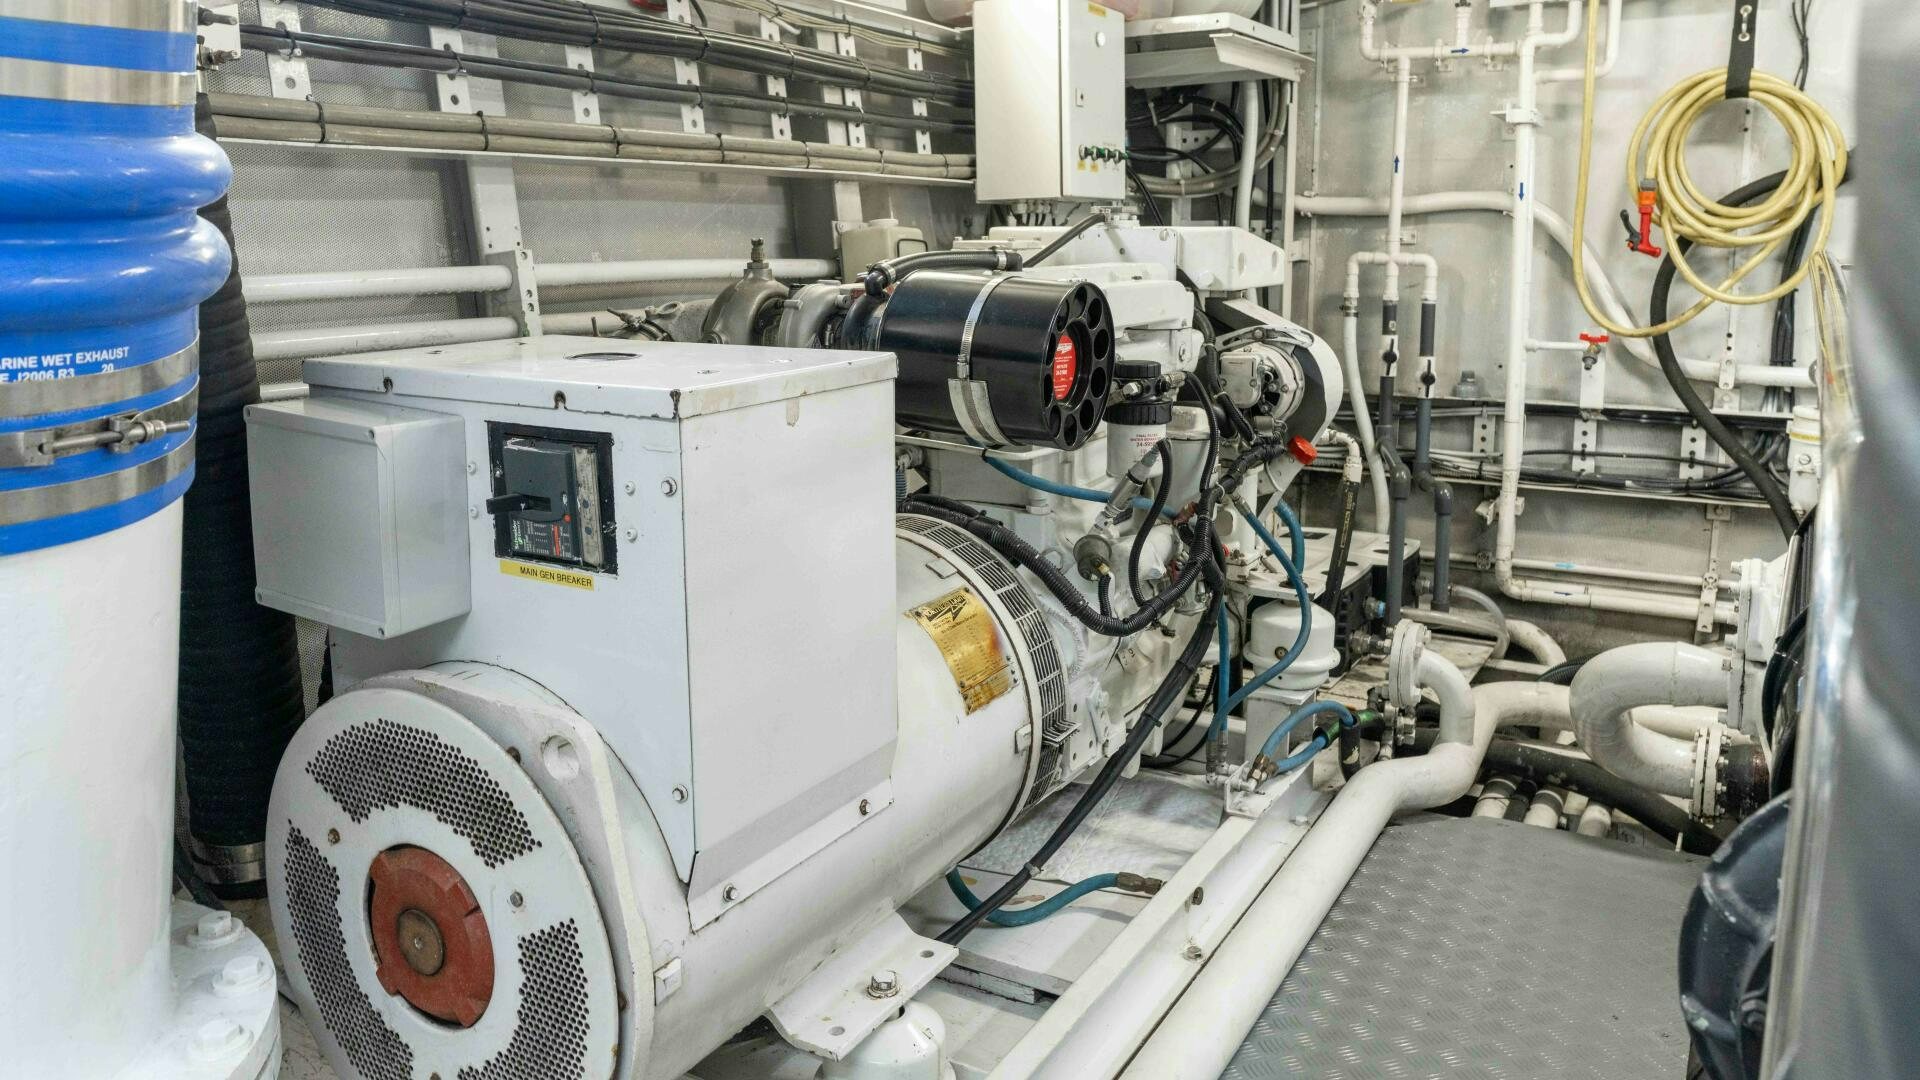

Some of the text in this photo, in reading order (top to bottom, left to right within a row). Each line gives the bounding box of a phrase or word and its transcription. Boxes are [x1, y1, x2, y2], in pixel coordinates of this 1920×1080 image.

[0, 347, 130, 370] RINE WET EXHAUST
[520, 565, 592, 587] MAIN GEN BREAKER
